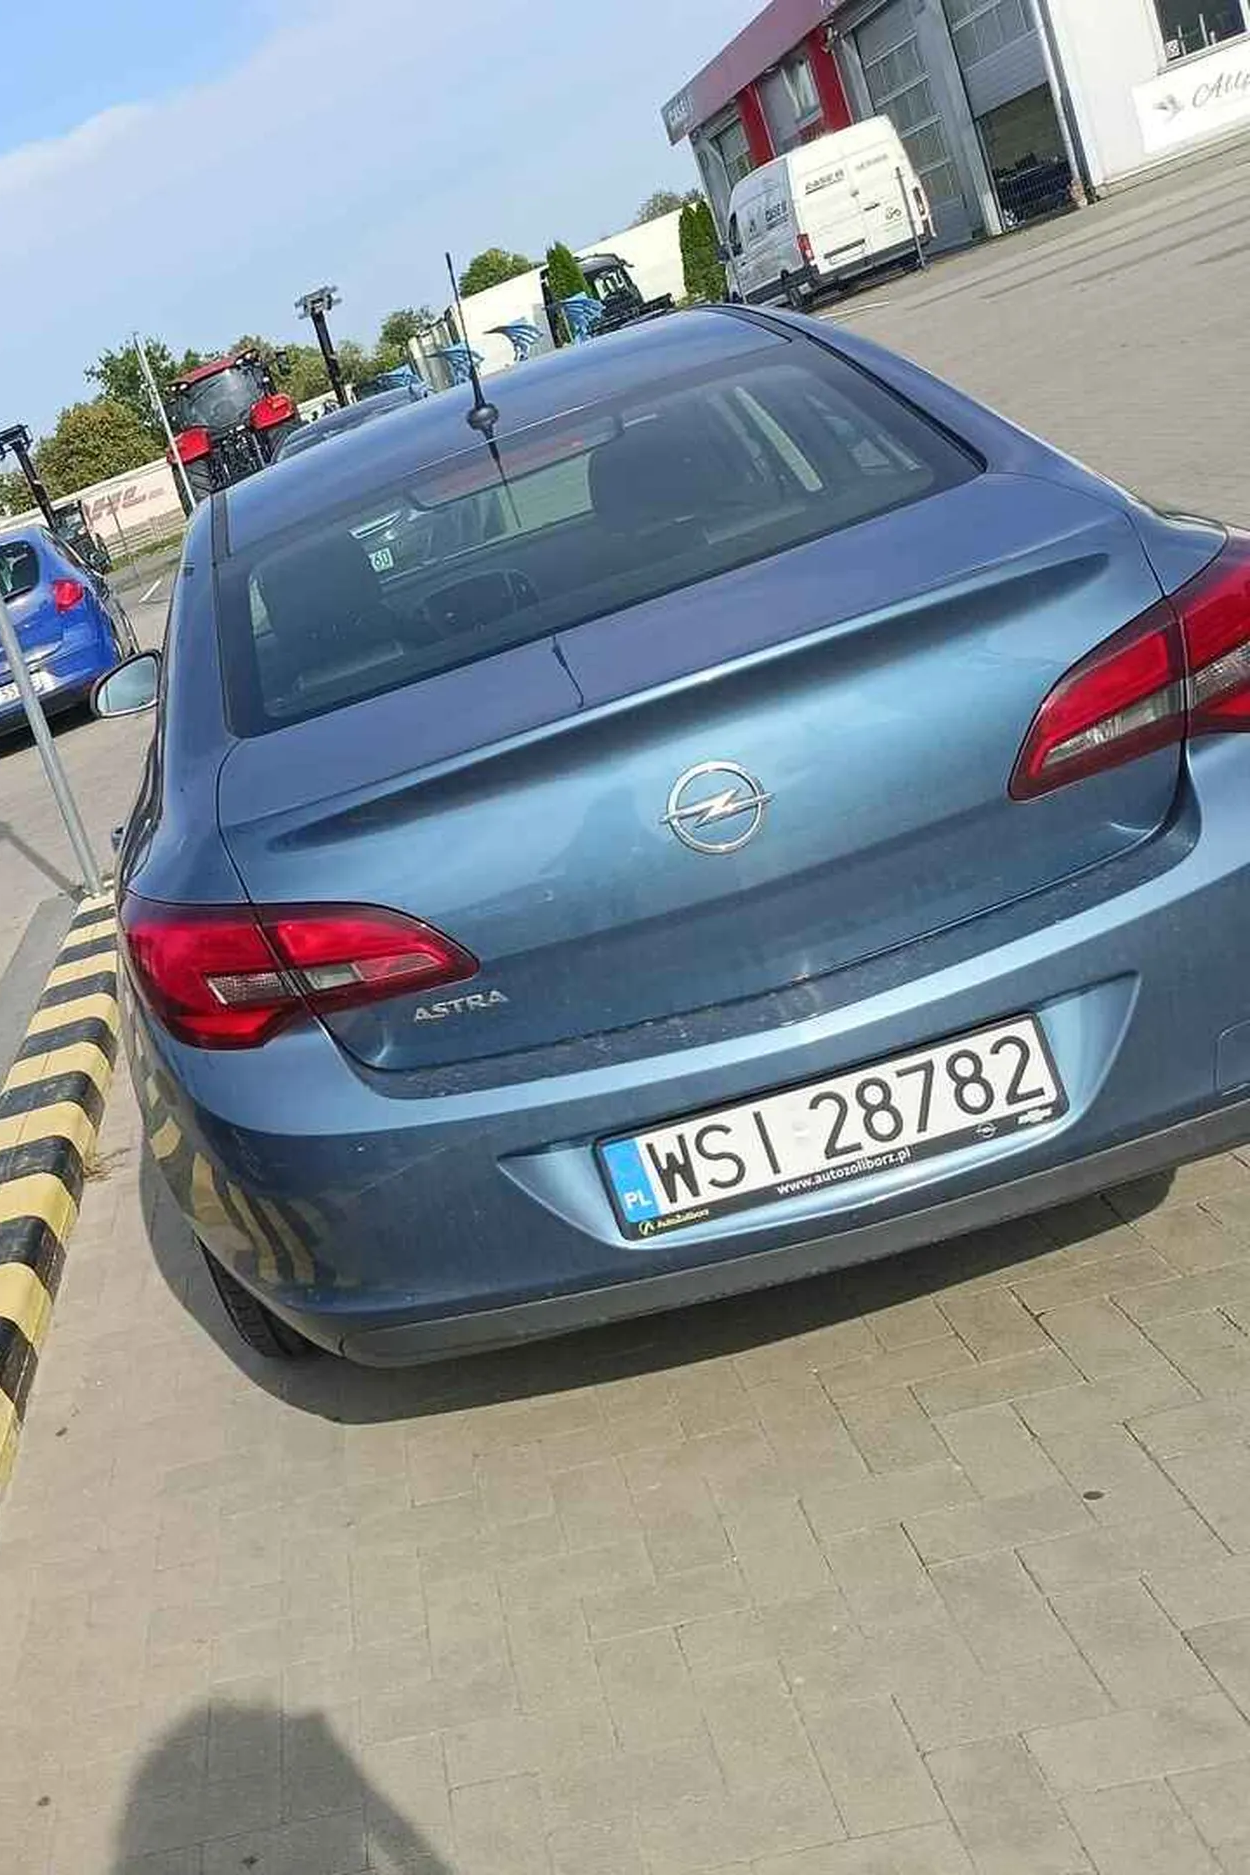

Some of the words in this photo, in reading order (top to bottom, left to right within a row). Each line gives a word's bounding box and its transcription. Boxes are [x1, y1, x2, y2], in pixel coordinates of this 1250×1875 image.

[414, 990, 509, 1022] ASTRA
[645, 1110, 782, 1204] WSI
[808, 1034, 1046, 1161] 28782
[776, 1147, 912, 1195] www.autozoliborz.pl
[624, 1189, 653, 1209] PL
